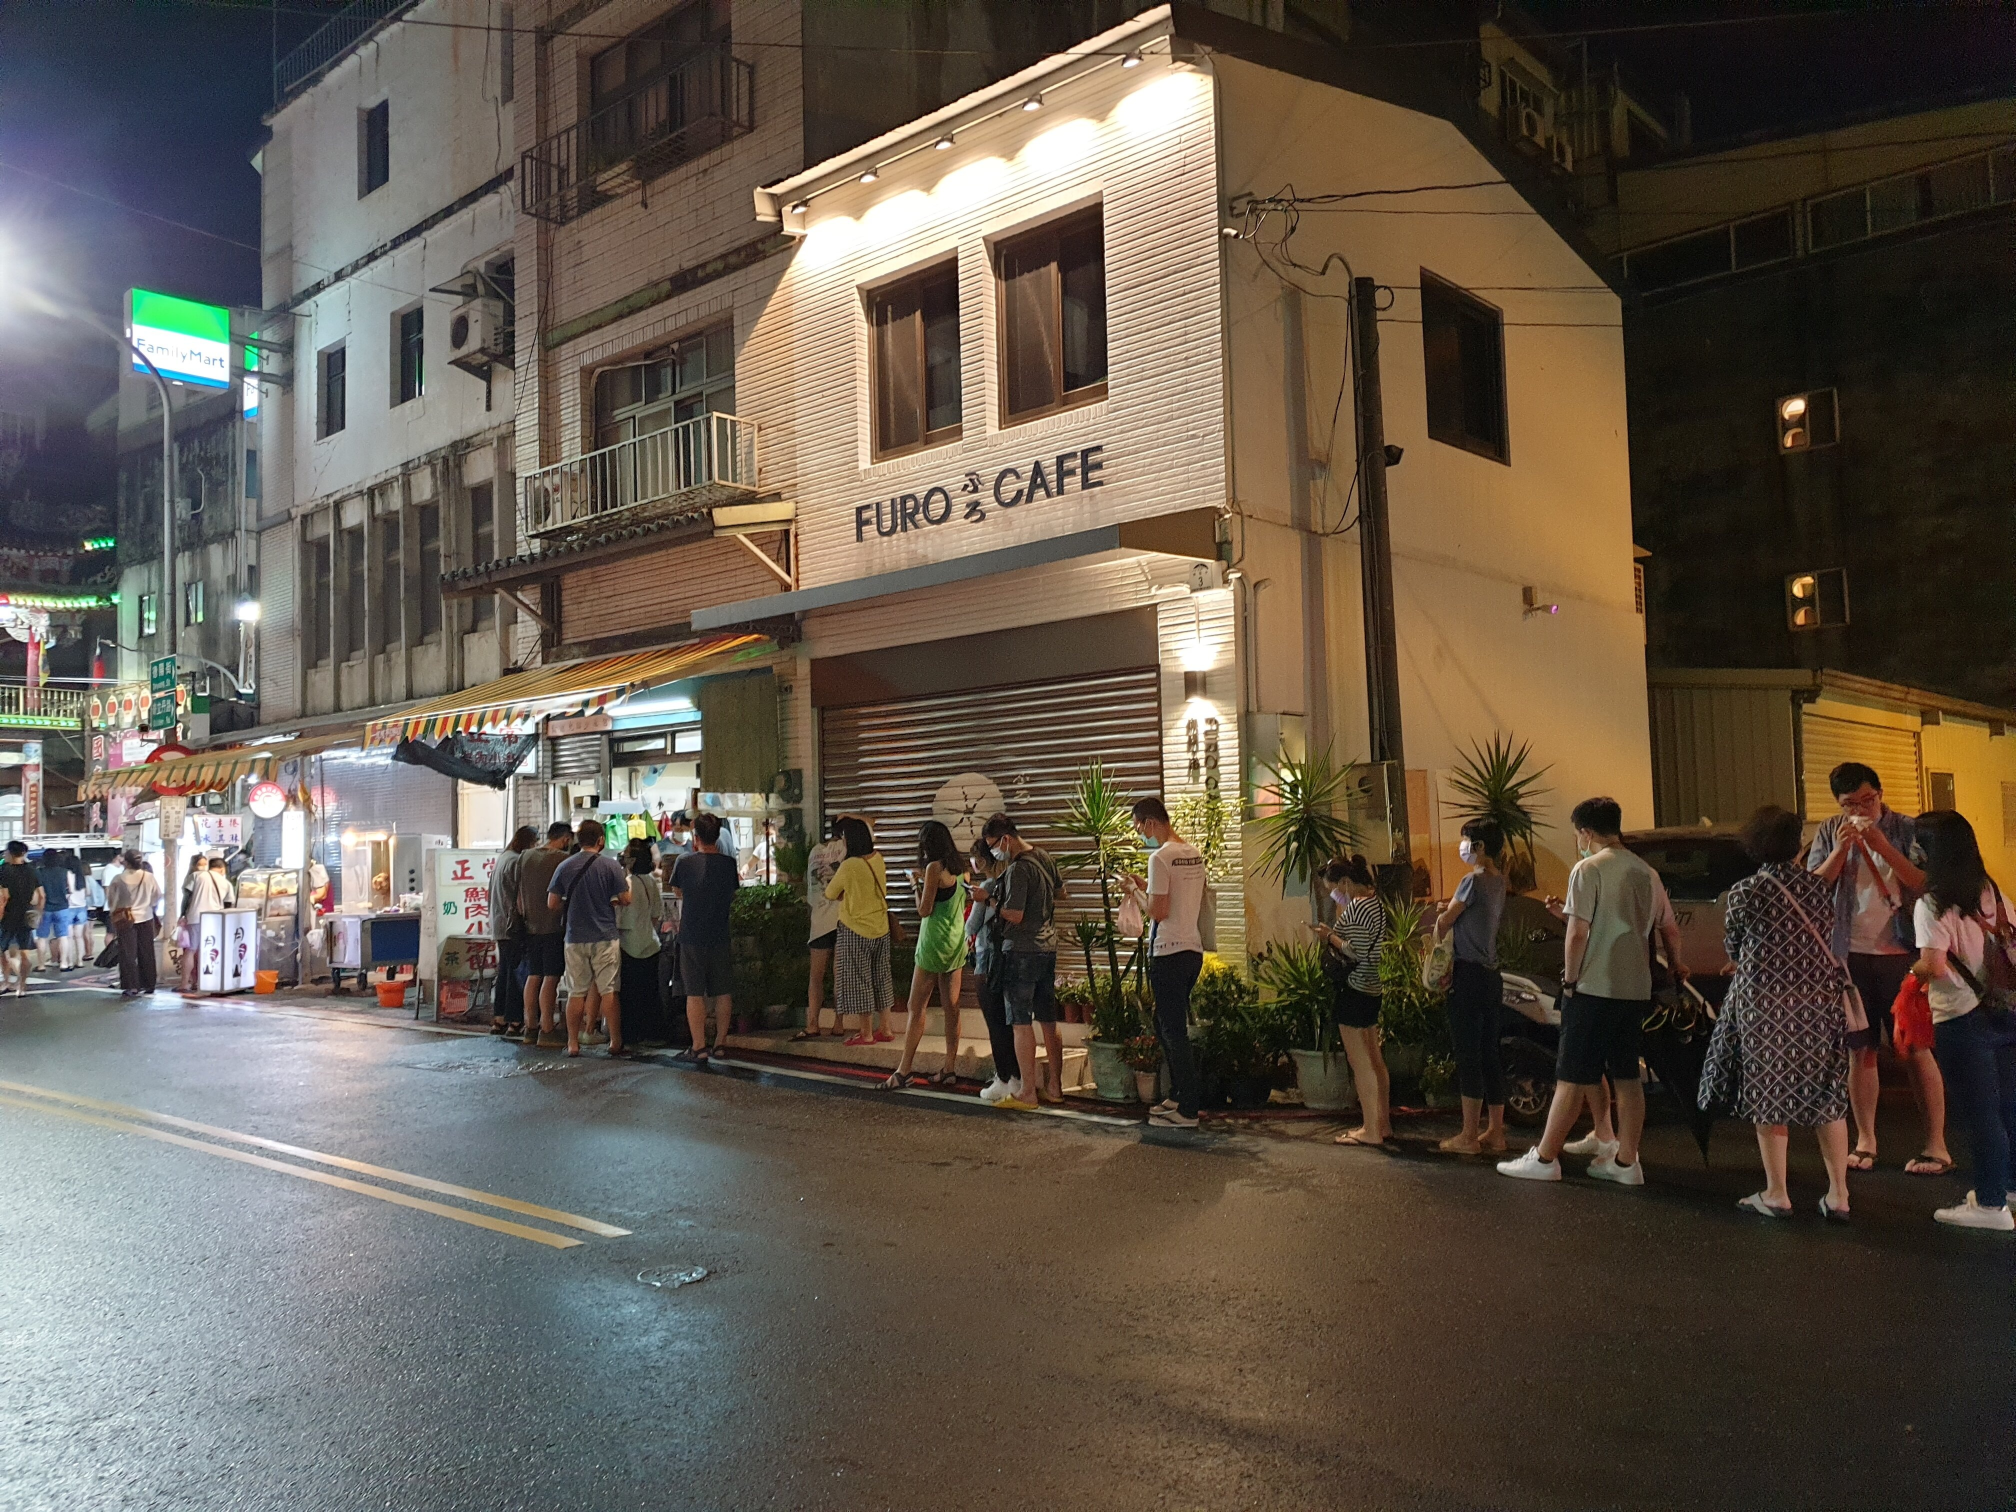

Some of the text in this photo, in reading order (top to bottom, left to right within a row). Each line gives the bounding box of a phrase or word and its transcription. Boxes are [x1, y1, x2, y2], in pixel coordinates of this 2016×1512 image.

[136, 337, 226, 369] FamilyMart
[855, 445, 1105, 543] FURO ふろ CAFE
[442, 901, 460, 967] 奶茶
